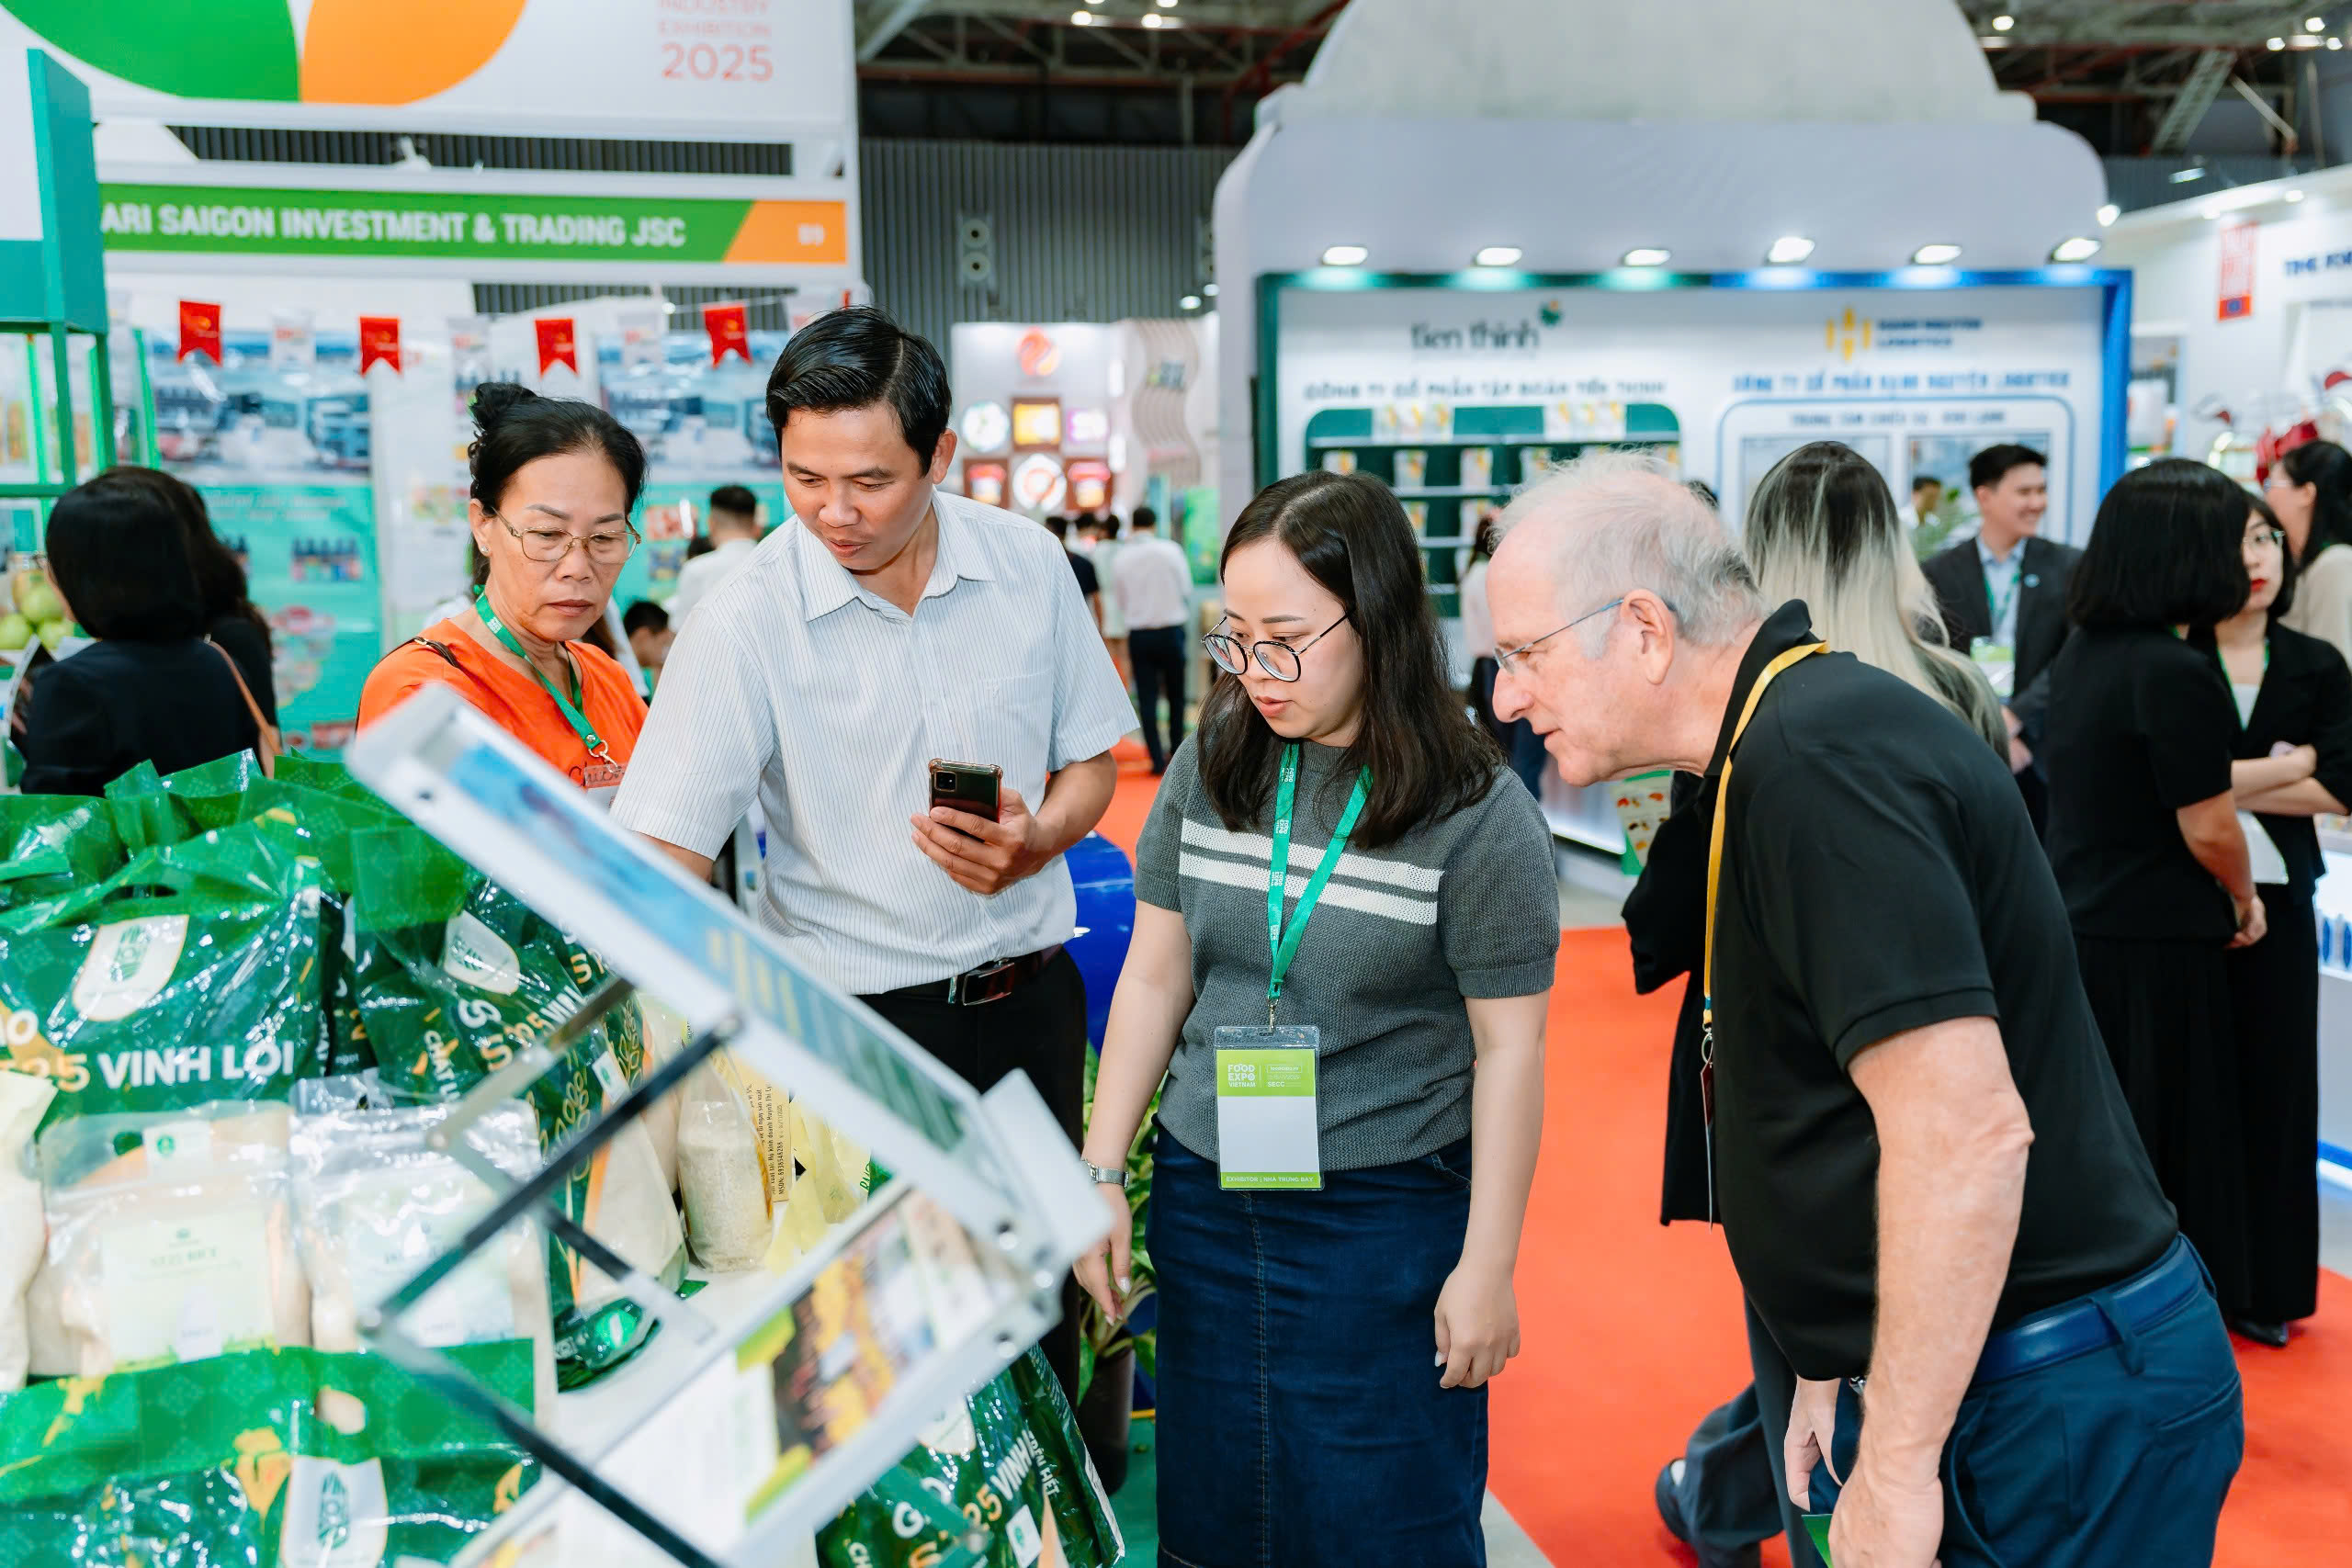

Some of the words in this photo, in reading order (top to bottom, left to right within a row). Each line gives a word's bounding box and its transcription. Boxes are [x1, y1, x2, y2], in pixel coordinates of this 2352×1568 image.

[662, 43, 774, 82] 2025
[101, 202, 152, 234] ARI
[158, 203, 275, 237] SAIGON
[281, 207, 469, 243] INVESTMENT
[472, 212, 495, 243] &
[501, 213, 626, 247] TRADING
[631, 216, 686, 247] JSC
[97, 1045, 212, 1090] VINH
[1227, 1063, 1256, 1073] FOOD
[1227, 1072, 1256, 1082] EXPO
[990, 1436, 1033, 1502] VINH
